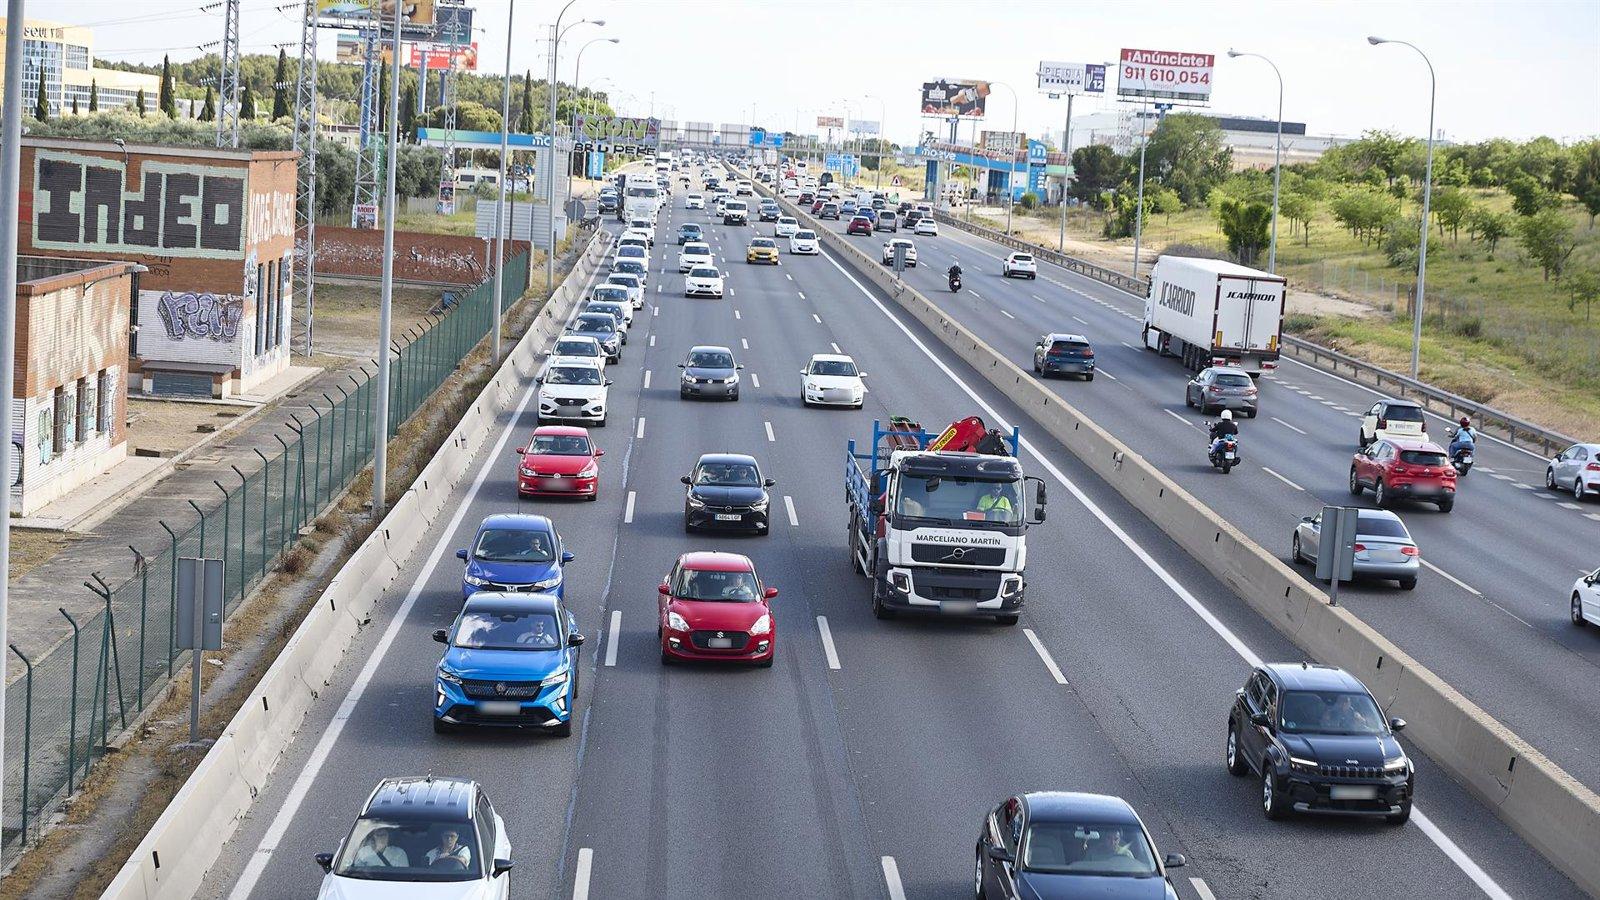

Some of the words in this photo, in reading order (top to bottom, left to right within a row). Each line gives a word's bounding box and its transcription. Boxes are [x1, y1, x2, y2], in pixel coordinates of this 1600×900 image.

[1127, 51, 1209, 67] ¡Anúnciate!
[1125, 66, 1145, 80] 911
[1150, 68, 1175, 82] 610
[1179, 71, 1209, 84] 054
[1159, 281, 1196, 317] JCARRION
[1226, 291, 1276, 302] JCARRION
[916, 534, 968, 544] MARCELIANO
[970, 537, 1001, 545] MARTÍN
